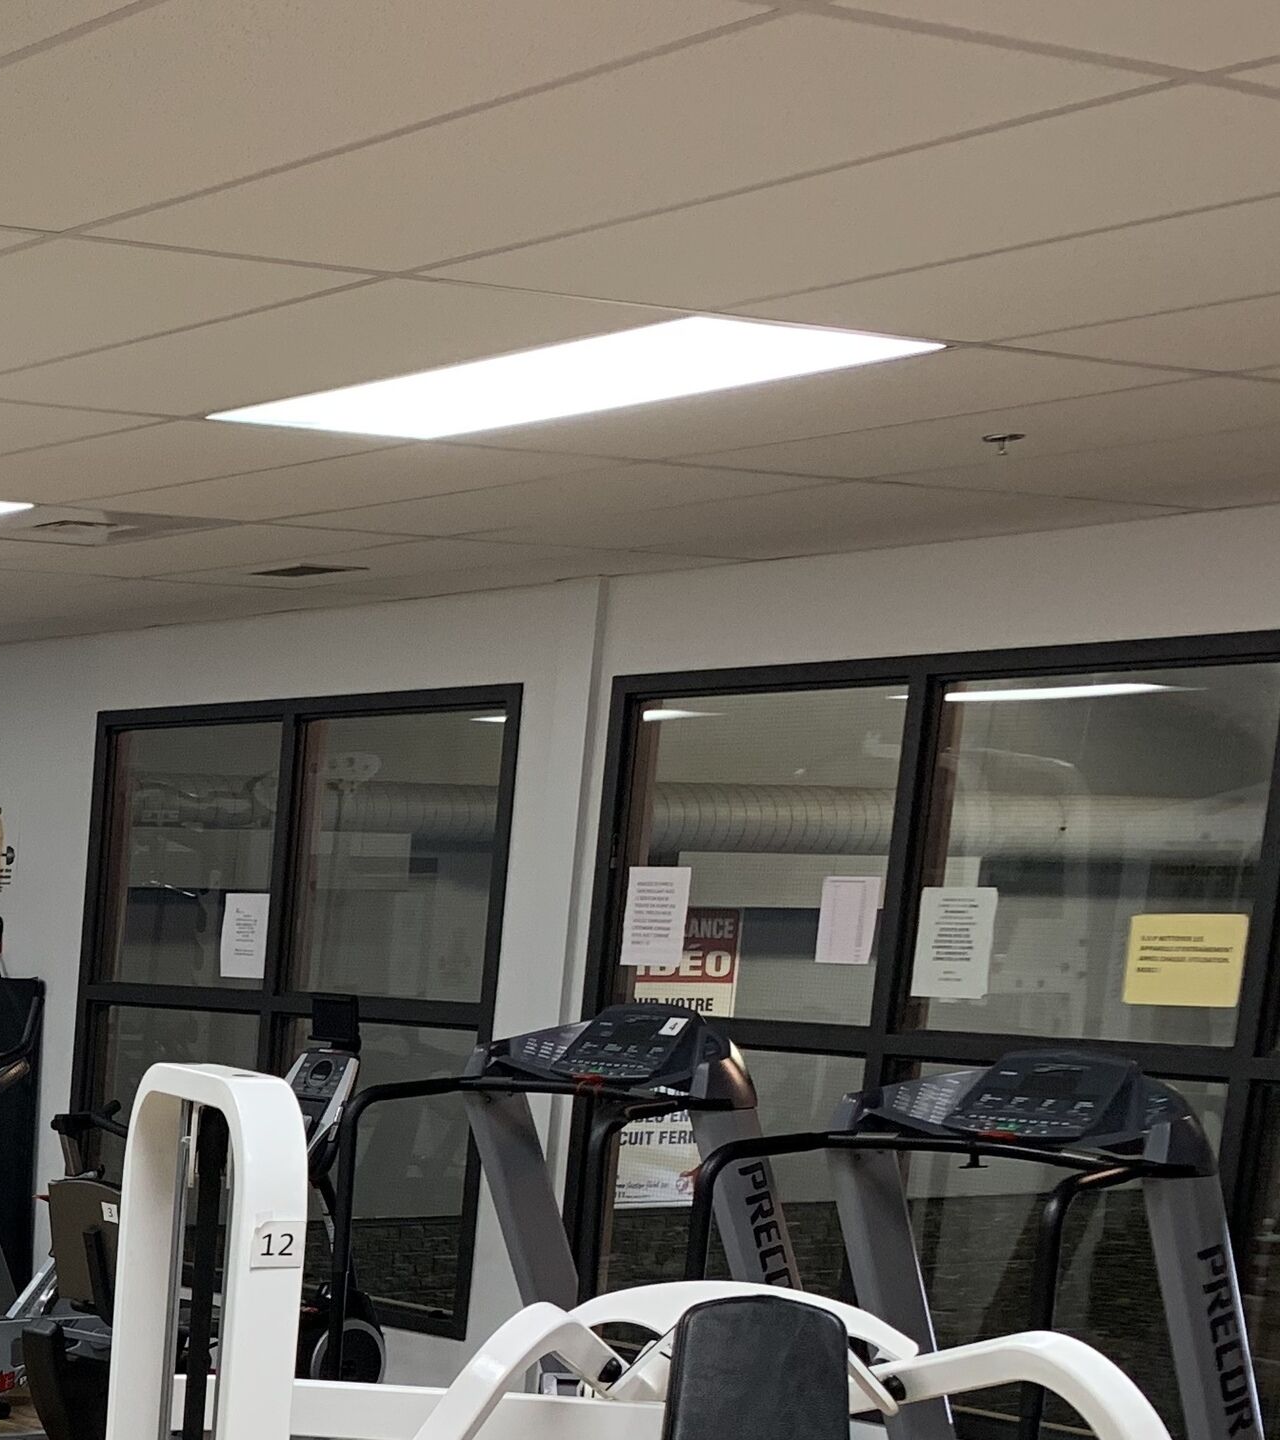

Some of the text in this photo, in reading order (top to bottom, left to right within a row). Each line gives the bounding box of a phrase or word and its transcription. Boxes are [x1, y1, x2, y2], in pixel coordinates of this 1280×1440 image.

[685, 918, 734, 938] ANCE
[260, 1233, 294, 1256] 12
[1196, 1244, 1255, 1438] PRECOR
